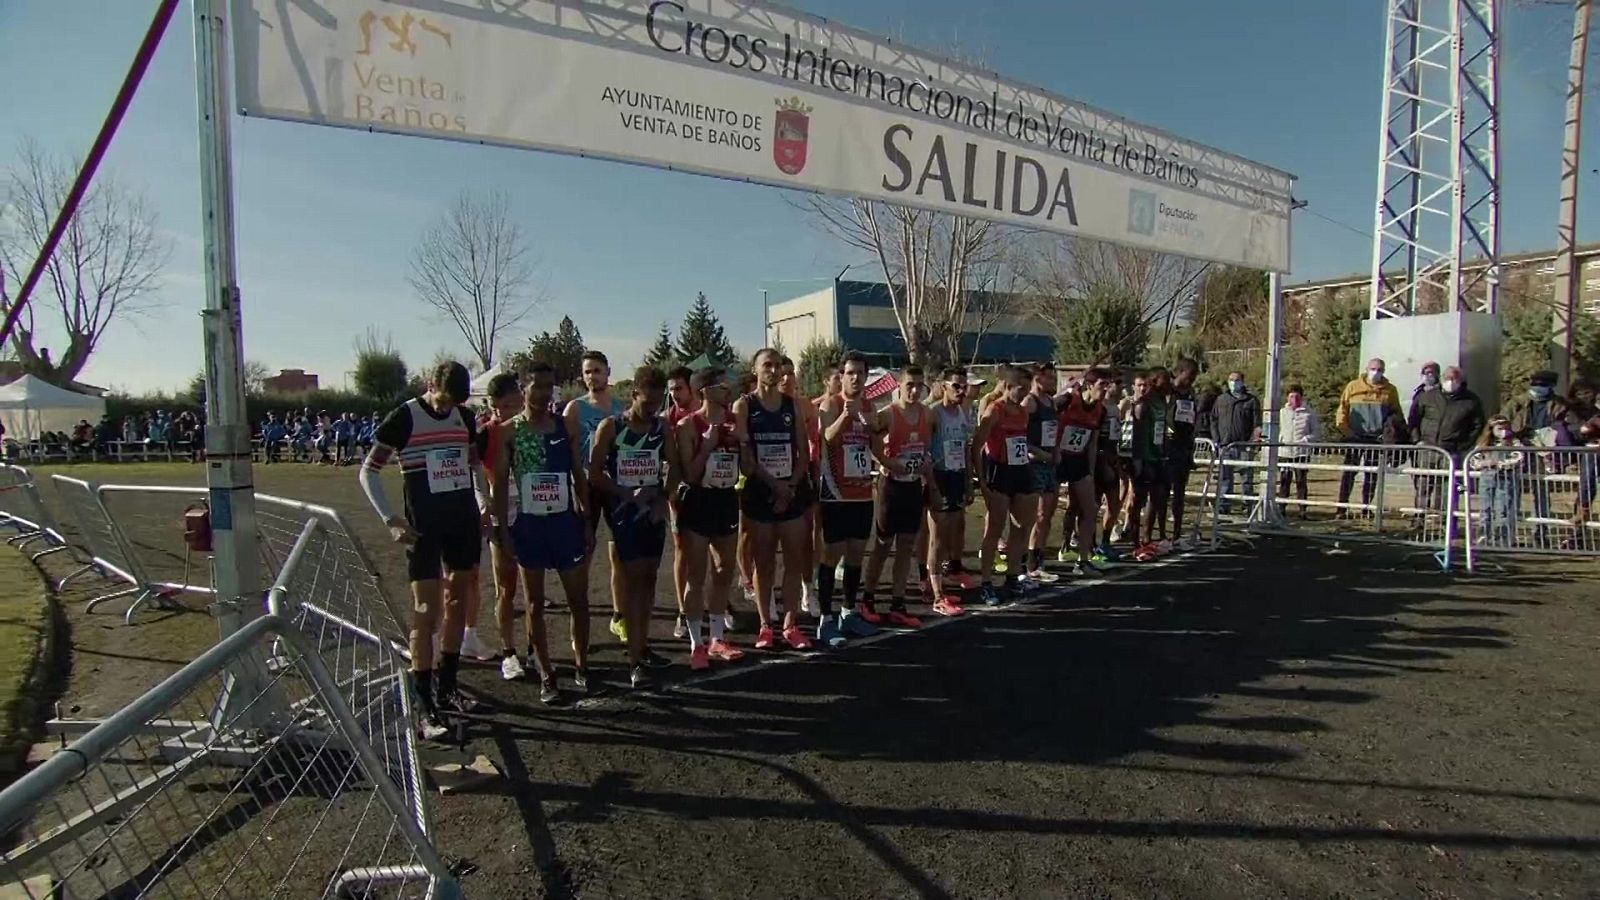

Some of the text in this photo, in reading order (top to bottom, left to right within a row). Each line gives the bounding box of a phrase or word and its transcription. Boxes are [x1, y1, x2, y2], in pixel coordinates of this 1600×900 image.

[354, 61, 446, 101] Venta
[646, 1, 1199, 188] Cross Internacional de Venta de Baños
[601, 86, 763, 131] AYUNTAMIENTO DE
[620, 112, 762, 152] VENTA DE BAÑOS
[883, 124, 1078, 226] SALIDA
[854, 452, 865, 468] 16
[1069, 434, 1081, 446] 24
